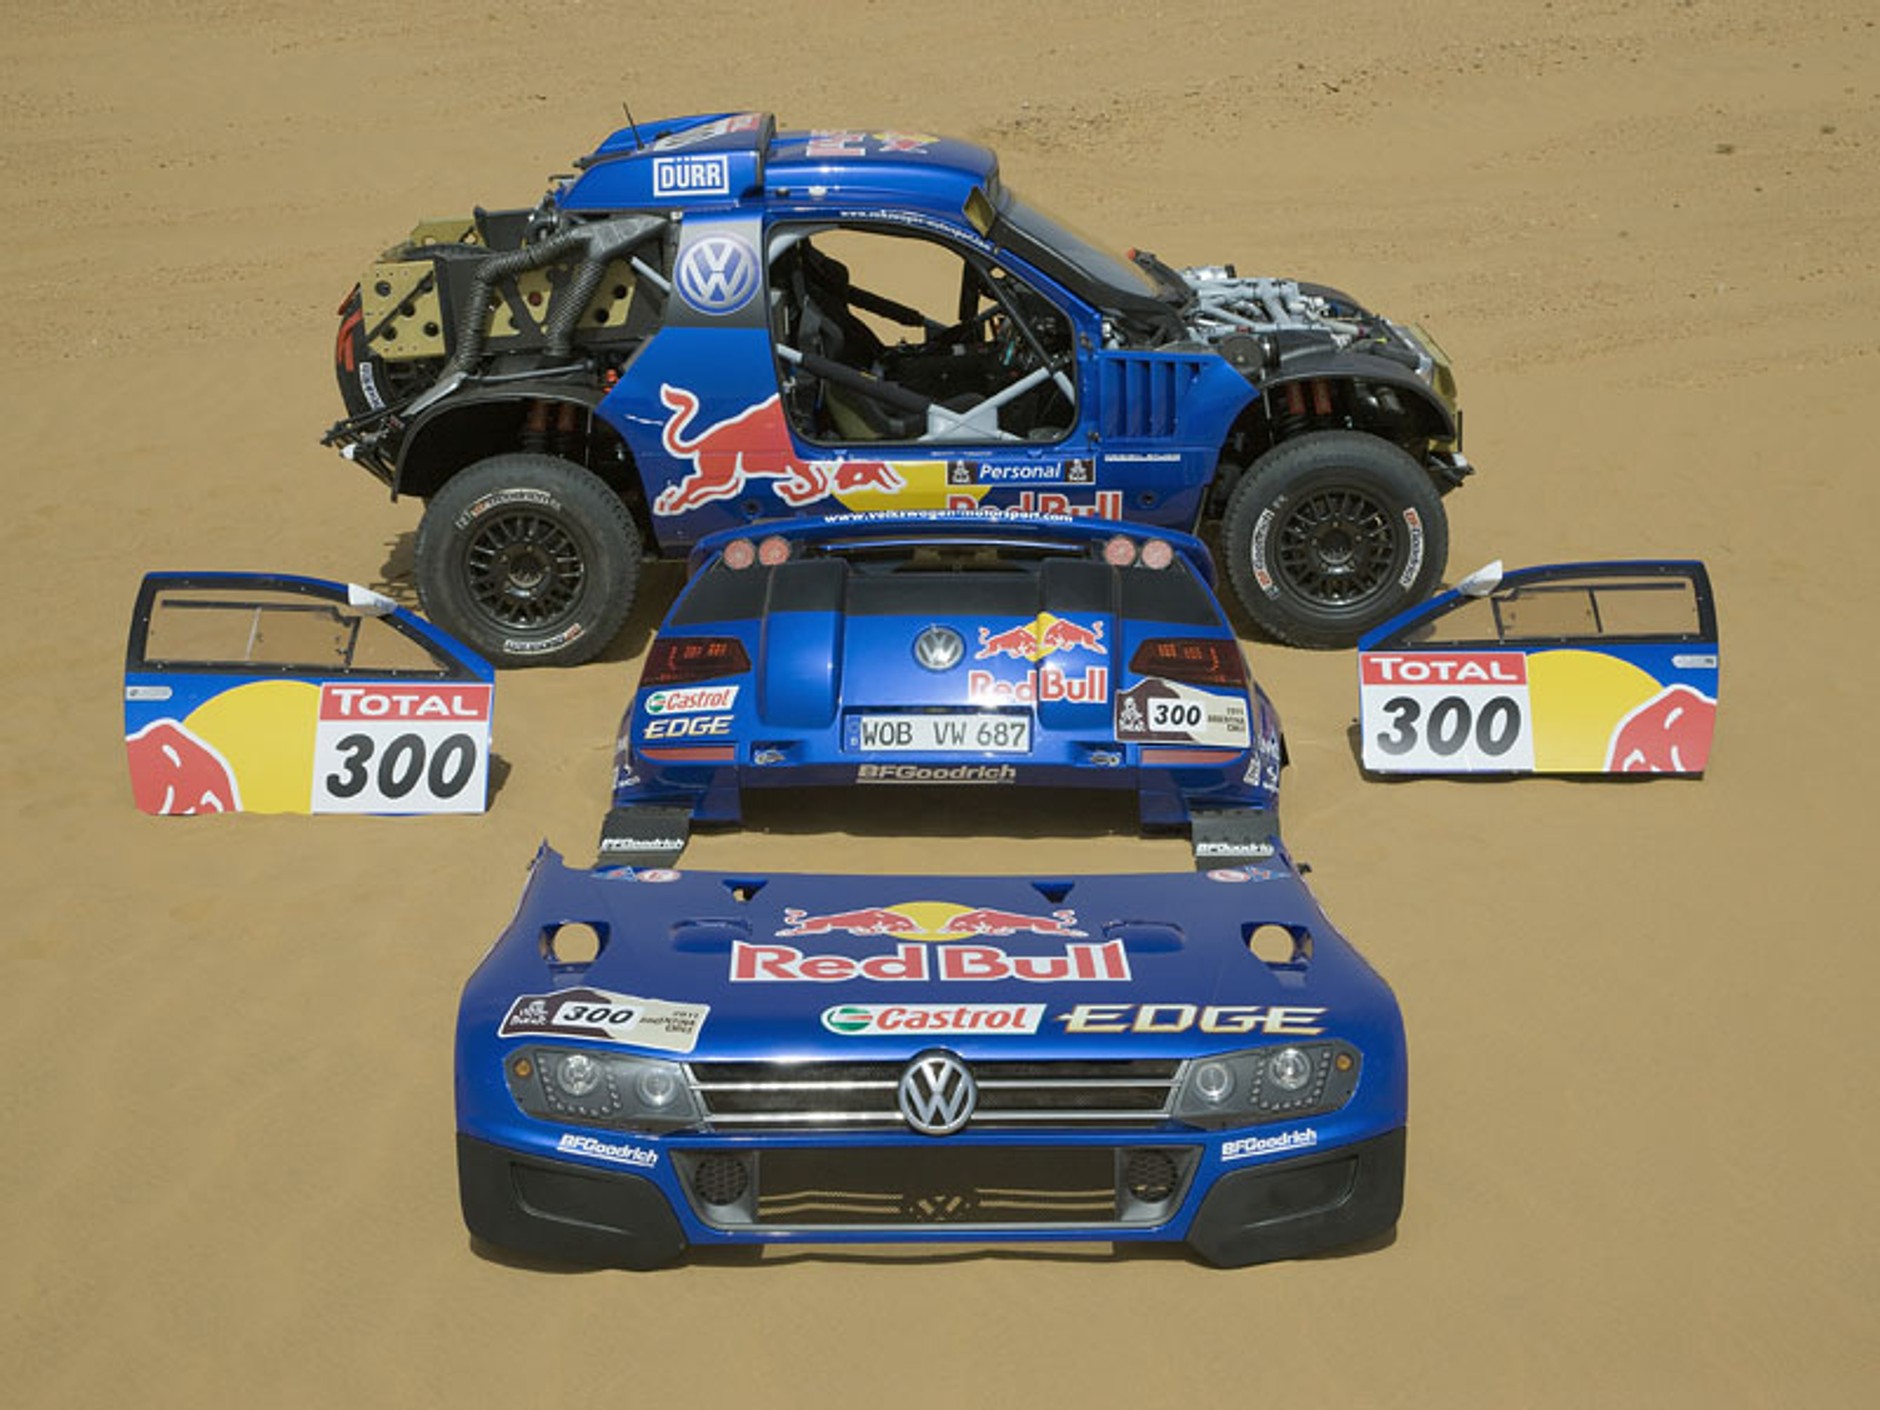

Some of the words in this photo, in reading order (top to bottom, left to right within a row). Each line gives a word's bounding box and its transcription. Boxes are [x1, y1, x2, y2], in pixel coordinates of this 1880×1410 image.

[661, 156, 722, 189] DÜRR
[979, 463, 1062, 480] Personal
[1369, 657, 1517, 682] TOTAL
[968, 668, 1037, 703] Red
[1040, 667, 1108, 703] Bull
[331, 689, 478, 716] TOTAL
[666, 689, 730, 711] Castrol
[644, 715, 734, 739] EDGE
[1154, 704, 1201, 726] 300
[1376, 695, 1521, 756] 300
[862, 722, 913, 747] WOB
[933, 722, 968, 746] VW
[977, 722, 1027, 747] 687
[325, 733, 477, 799] 300
[857, 764, 1017, 782] BFGoodrich
[730, 941, 930, 982] Red
[937, 938, 1132, 982] Bull
[563, 1006, 634, 1024] 300
[876, 1007, 1027, 1029] Castrol
[1054, 1004, 1329, 1035] EDGE
[557, 1135, 658, 1168] BFGoodrich
[1221, 1129, 1317, 1162] BFGoodrich
